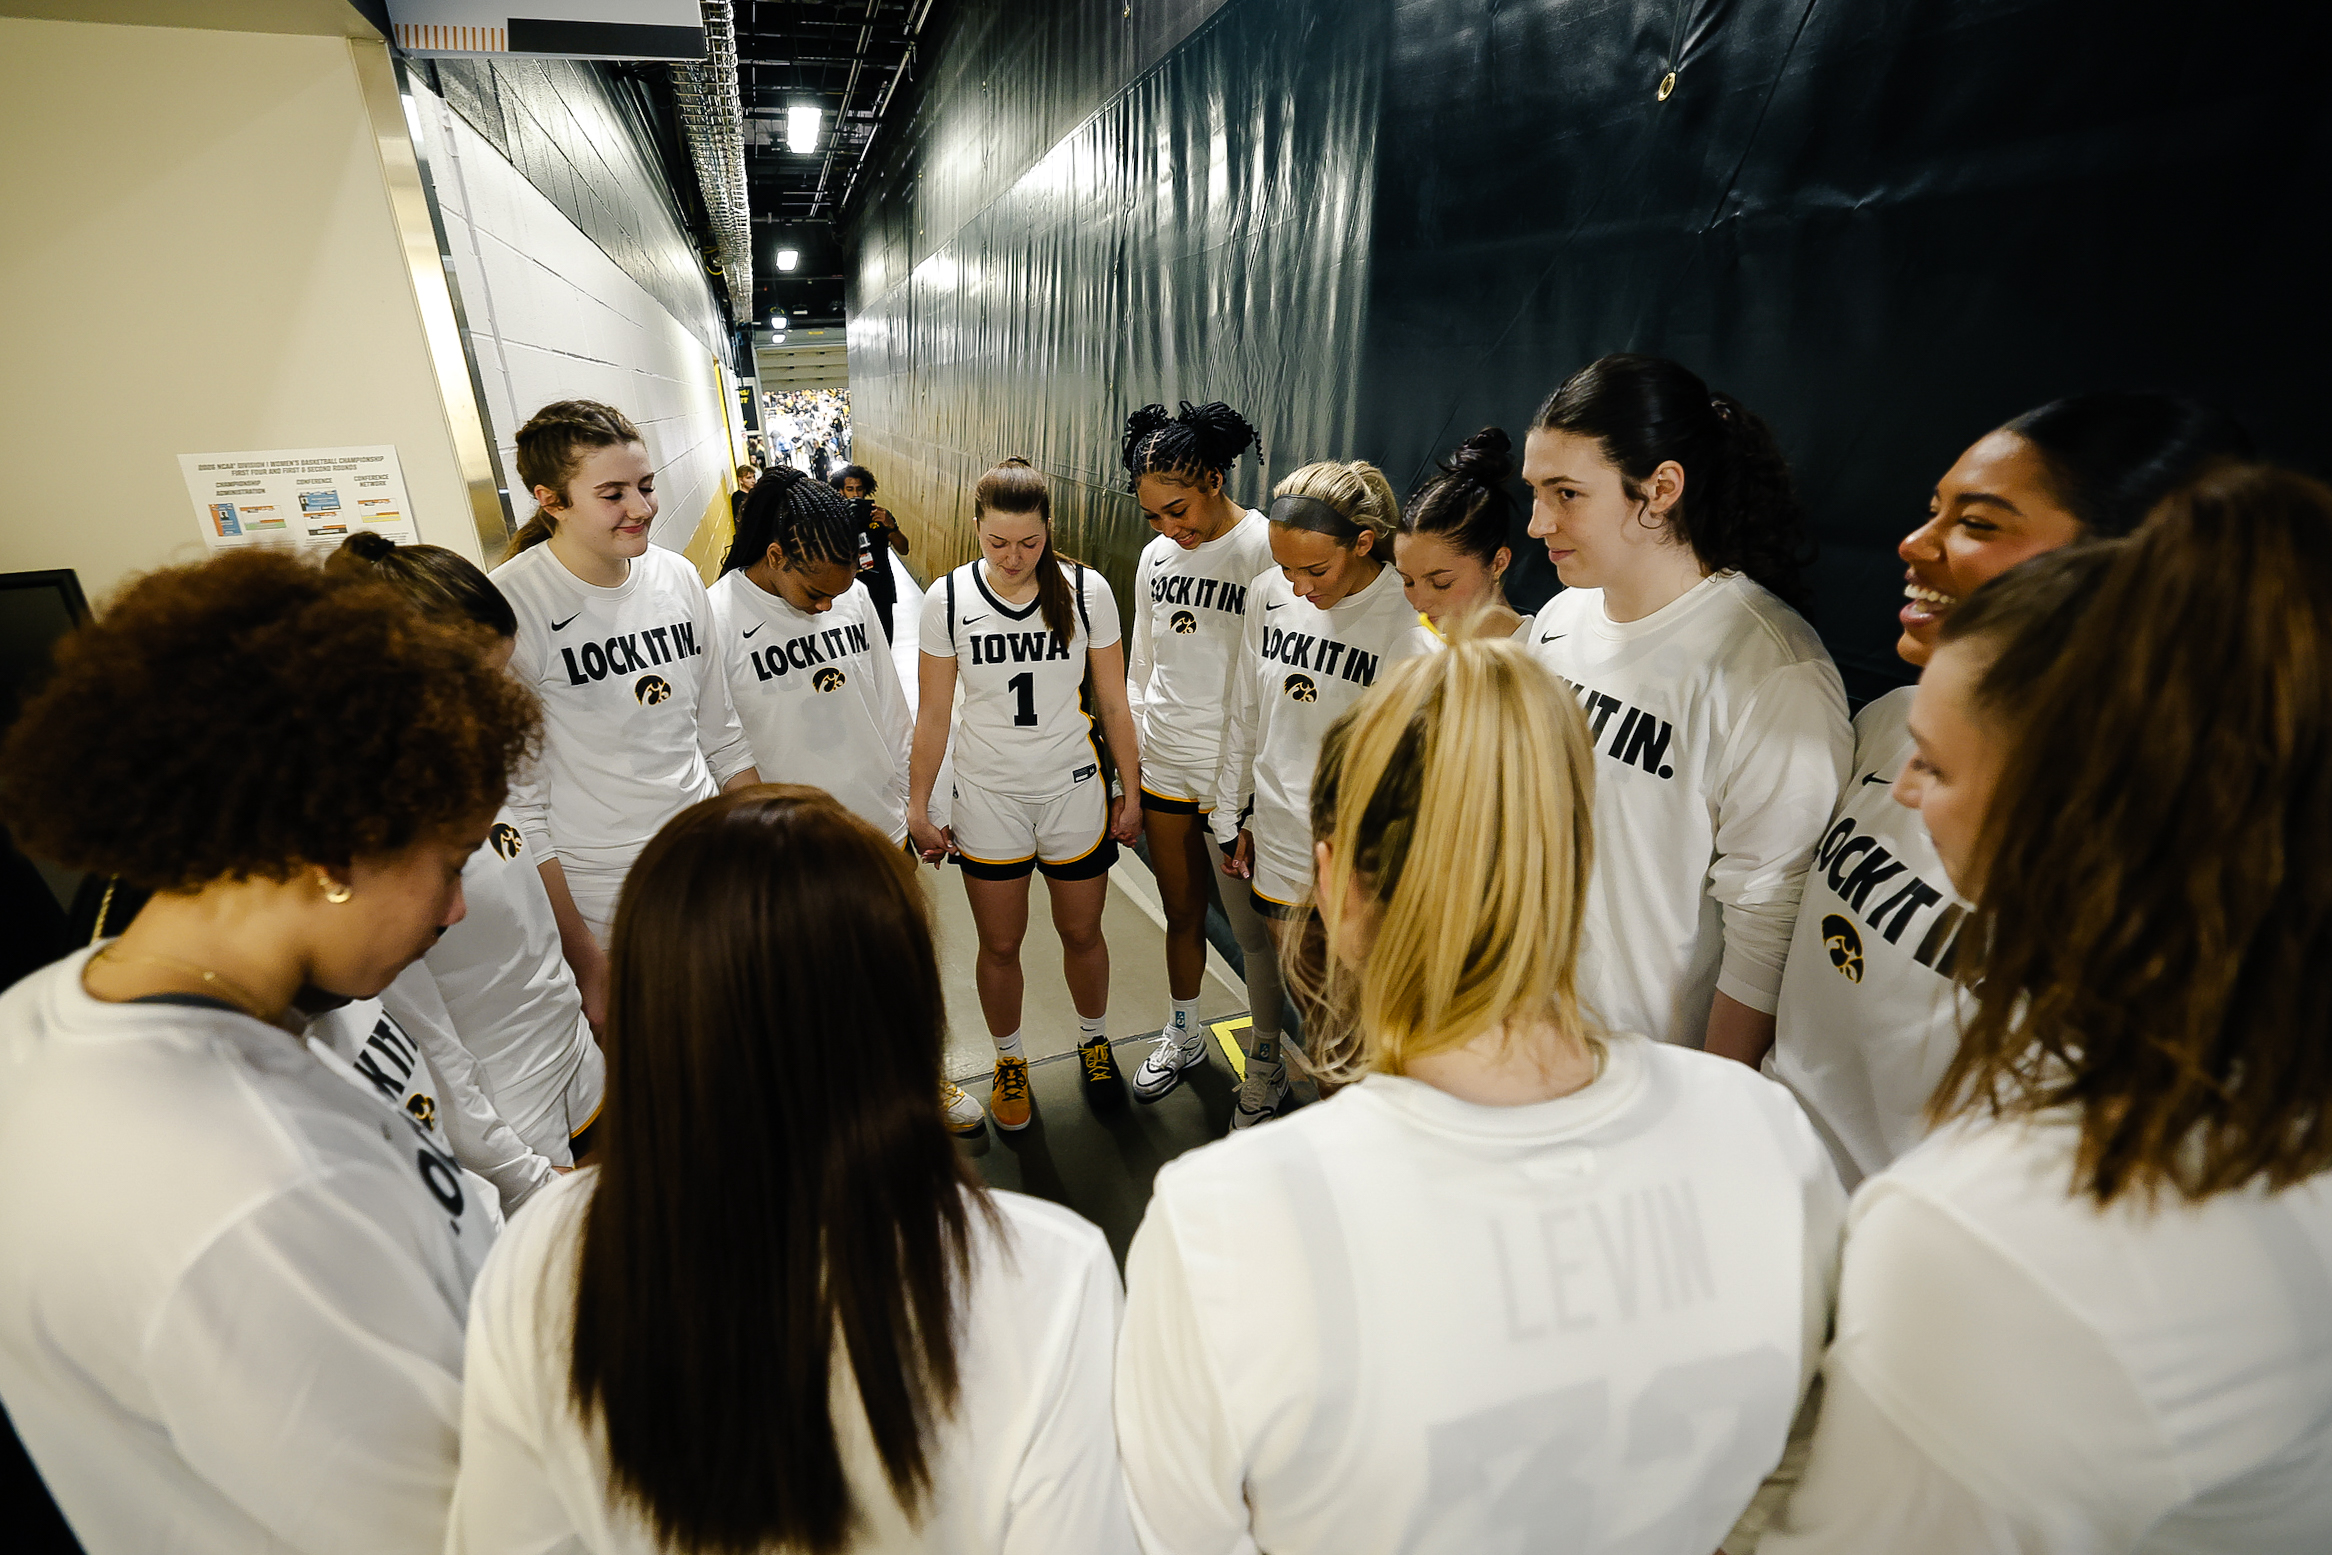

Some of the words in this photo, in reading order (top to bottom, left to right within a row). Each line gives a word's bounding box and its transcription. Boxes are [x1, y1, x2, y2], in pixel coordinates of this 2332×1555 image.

[301, 458, 338, 466] BASKETBALL
[339, 456, 384, 464] CHAMPIONSHIP
[354, 474, 390, 482] CONFERENCE
[1194, 578, 1219, 608] IT
[561, 633, 649, 685] LOCK
[641, 627, 672, 666] IT
[670, 622, 701, 659] IN.
[750, 634, 826, 681] LOCK
[820, 628, 847, 660] IT
[970, 631, 1070, 665] IOWA
[1314, 638, 1346, 676] IT
[1341, 647, 1379, 687] IN
[1008, 672, 1038, 726] 1
[1608, 707, 1673, 779] IN.
[1816, 817, 1908, 914] OCK
[1865, 876, 1943, 945] IT
[1488, 1176, 1717, 1344] LEVIN
